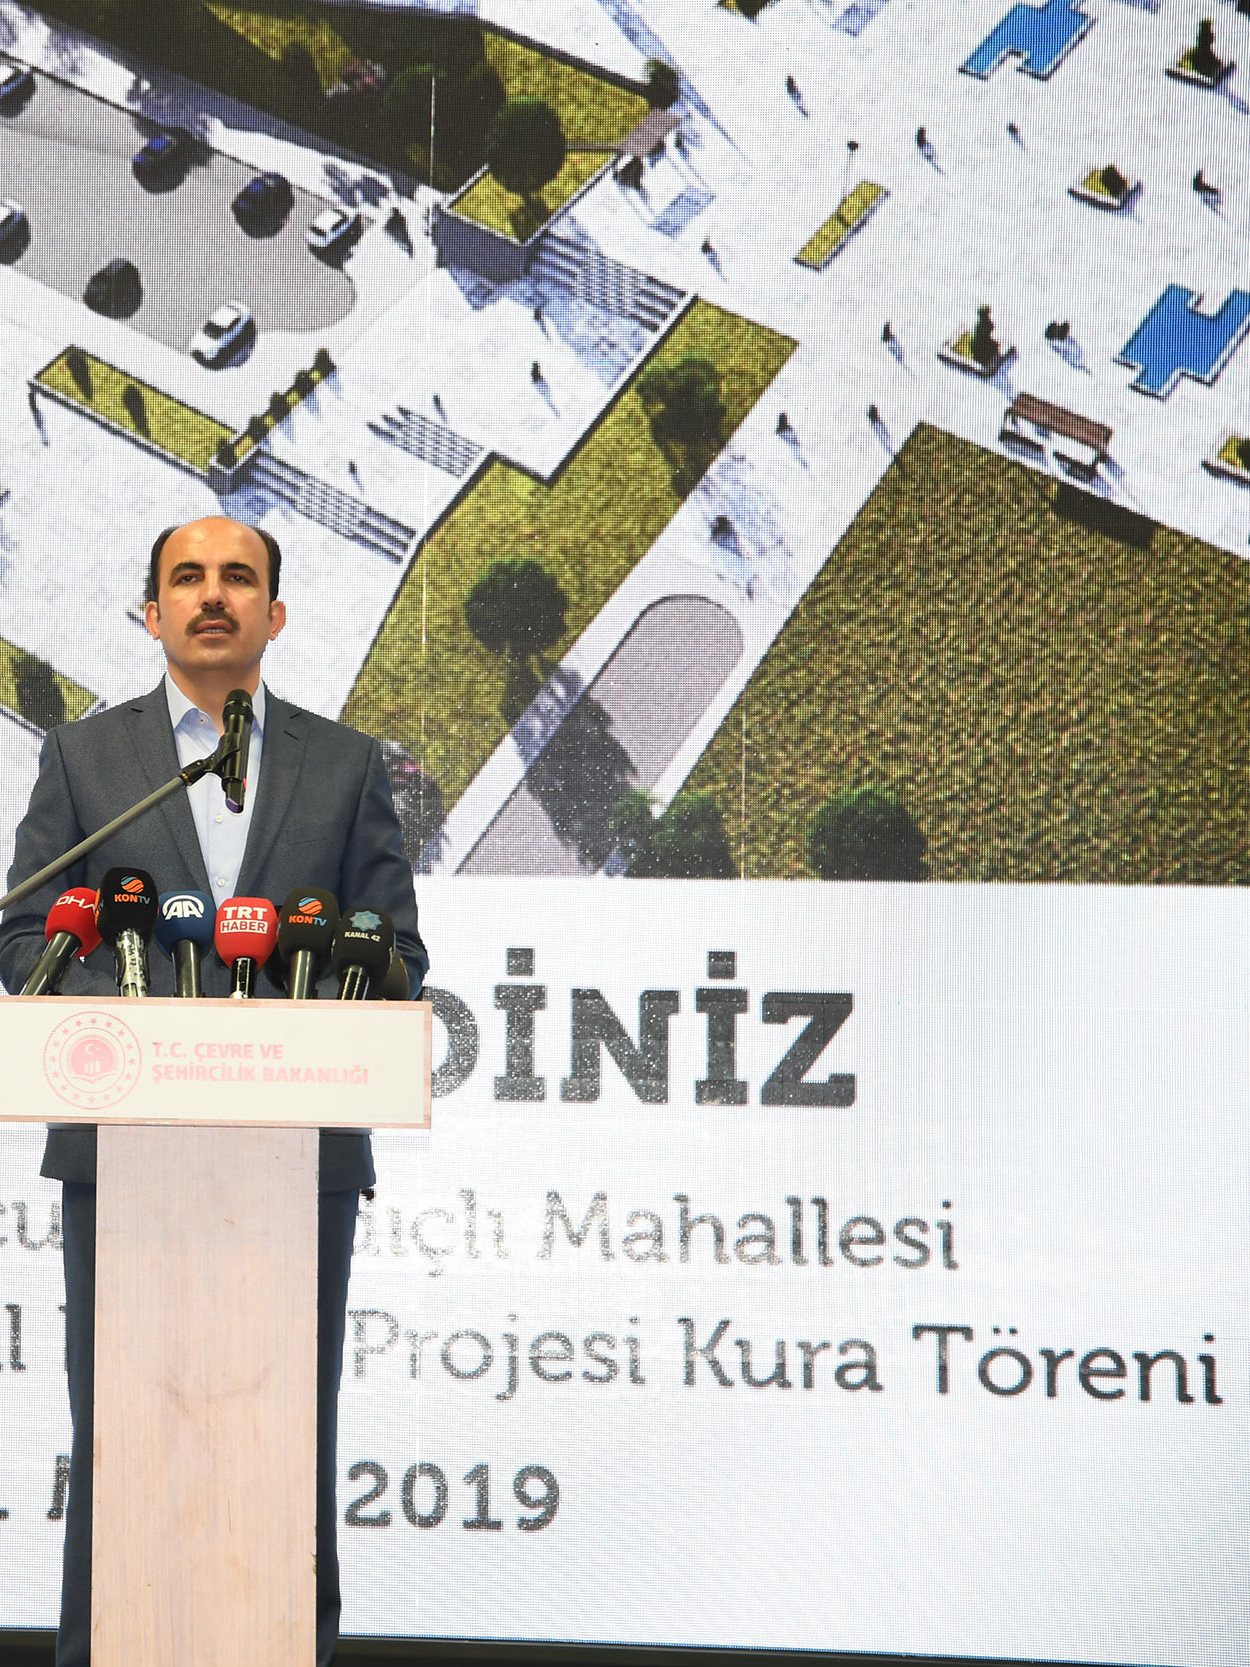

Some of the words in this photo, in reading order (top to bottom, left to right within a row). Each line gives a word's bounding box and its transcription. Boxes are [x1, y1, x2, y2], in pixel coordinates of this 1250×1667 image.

[114, 894, 150, 904] KONTV
[163, 896, 204, 920] AA
[224, 906, 267, 920] TRT
[289, 915, 327, 926] KONTV
[221, 921, 267, 933] HABER
[344, 931, 370, 940] KANAL
[370, 933, 381, 942] 42
[152, 1042, 187, 1058] T.C.
[194, 1042, 254, 1062] ÇEVRE
[260, 1044, 283, 1060] VE
[152, 1062, 257, 1084] ŞEHİRCİLİK
[263, 1065, 369, 1085] BAKANLIĞI
[537, 1190, 959, 1271] Mahallesi
[348, 1309, 645, 1402] Projesi
[678, 1316, 884, 1393] Kura
[912, 1323, 1225, 1407] Töreni
[344, 1461, 561, 1533] 2019
